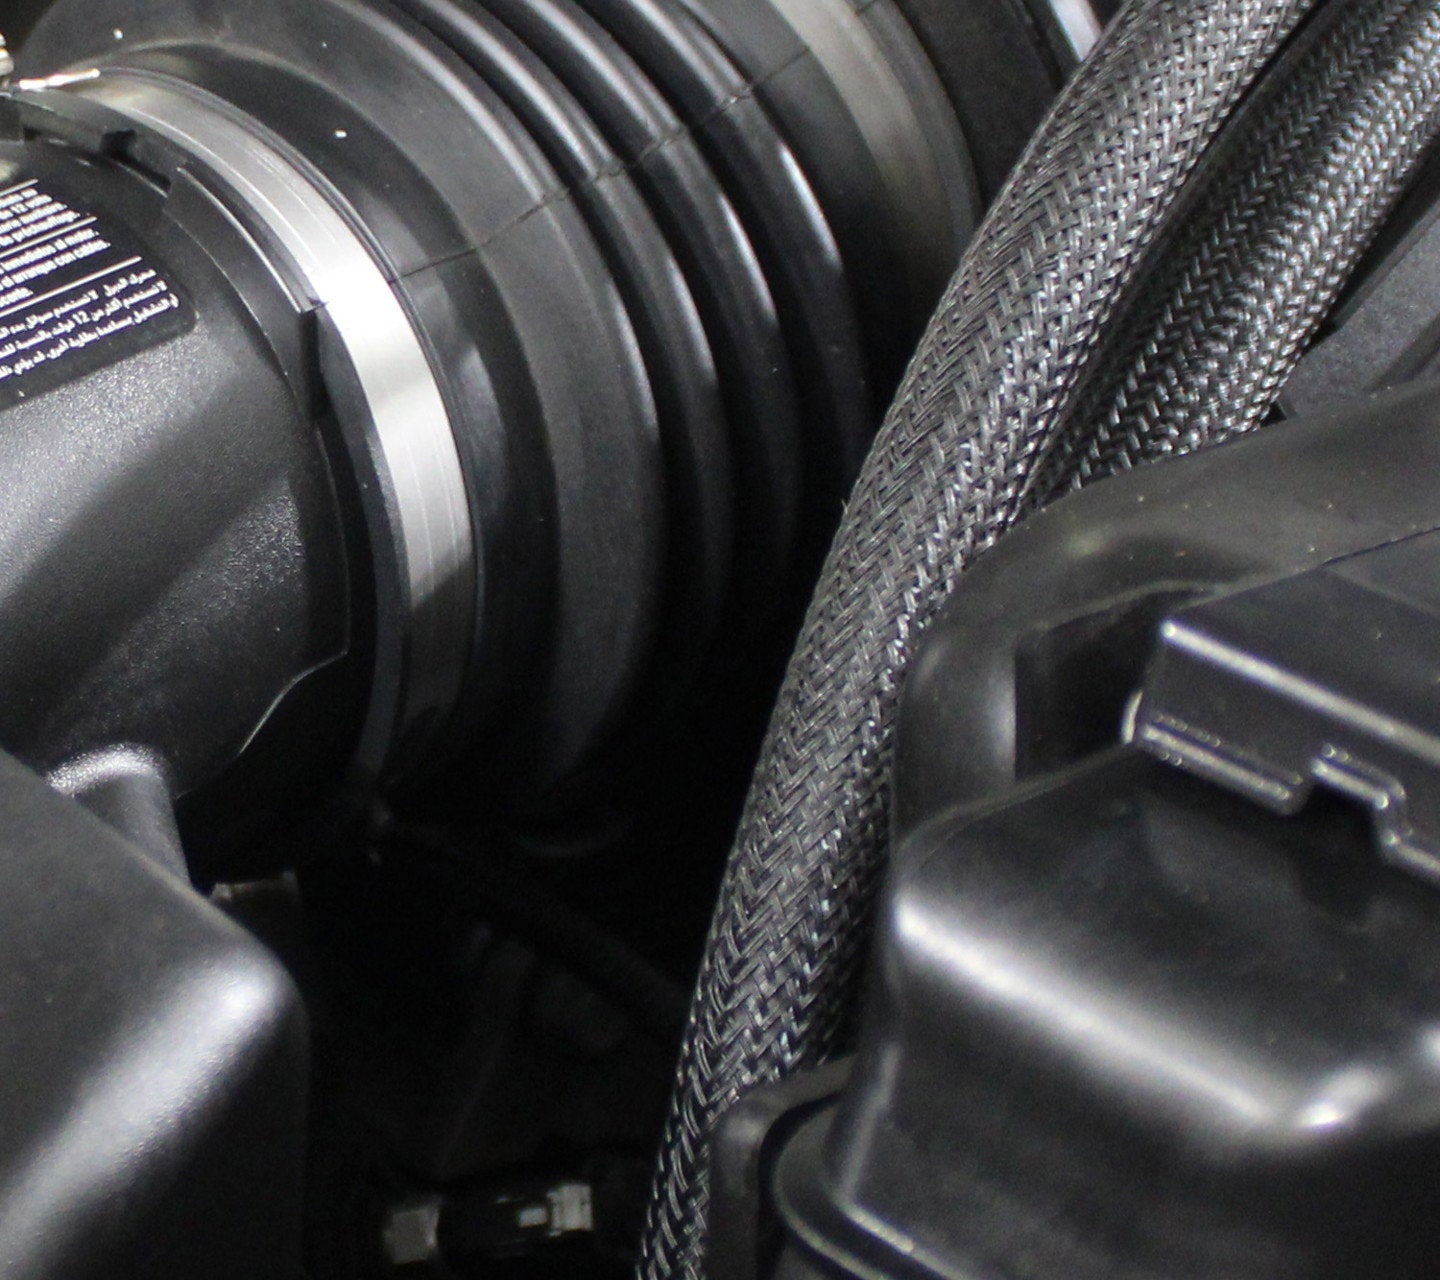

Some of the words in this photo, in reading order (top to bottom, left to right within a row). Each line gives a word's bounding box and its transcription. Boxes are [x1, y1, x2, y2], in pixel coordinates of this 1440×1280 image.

[10, 203, 27, 213] 12
[53, 238, 67, 250] al
[0, 276, 14, 287] el
[11, 260, 56, 283] arranque
[53, 252, 76, 265] con
[72, 310, 95, 324] 12
